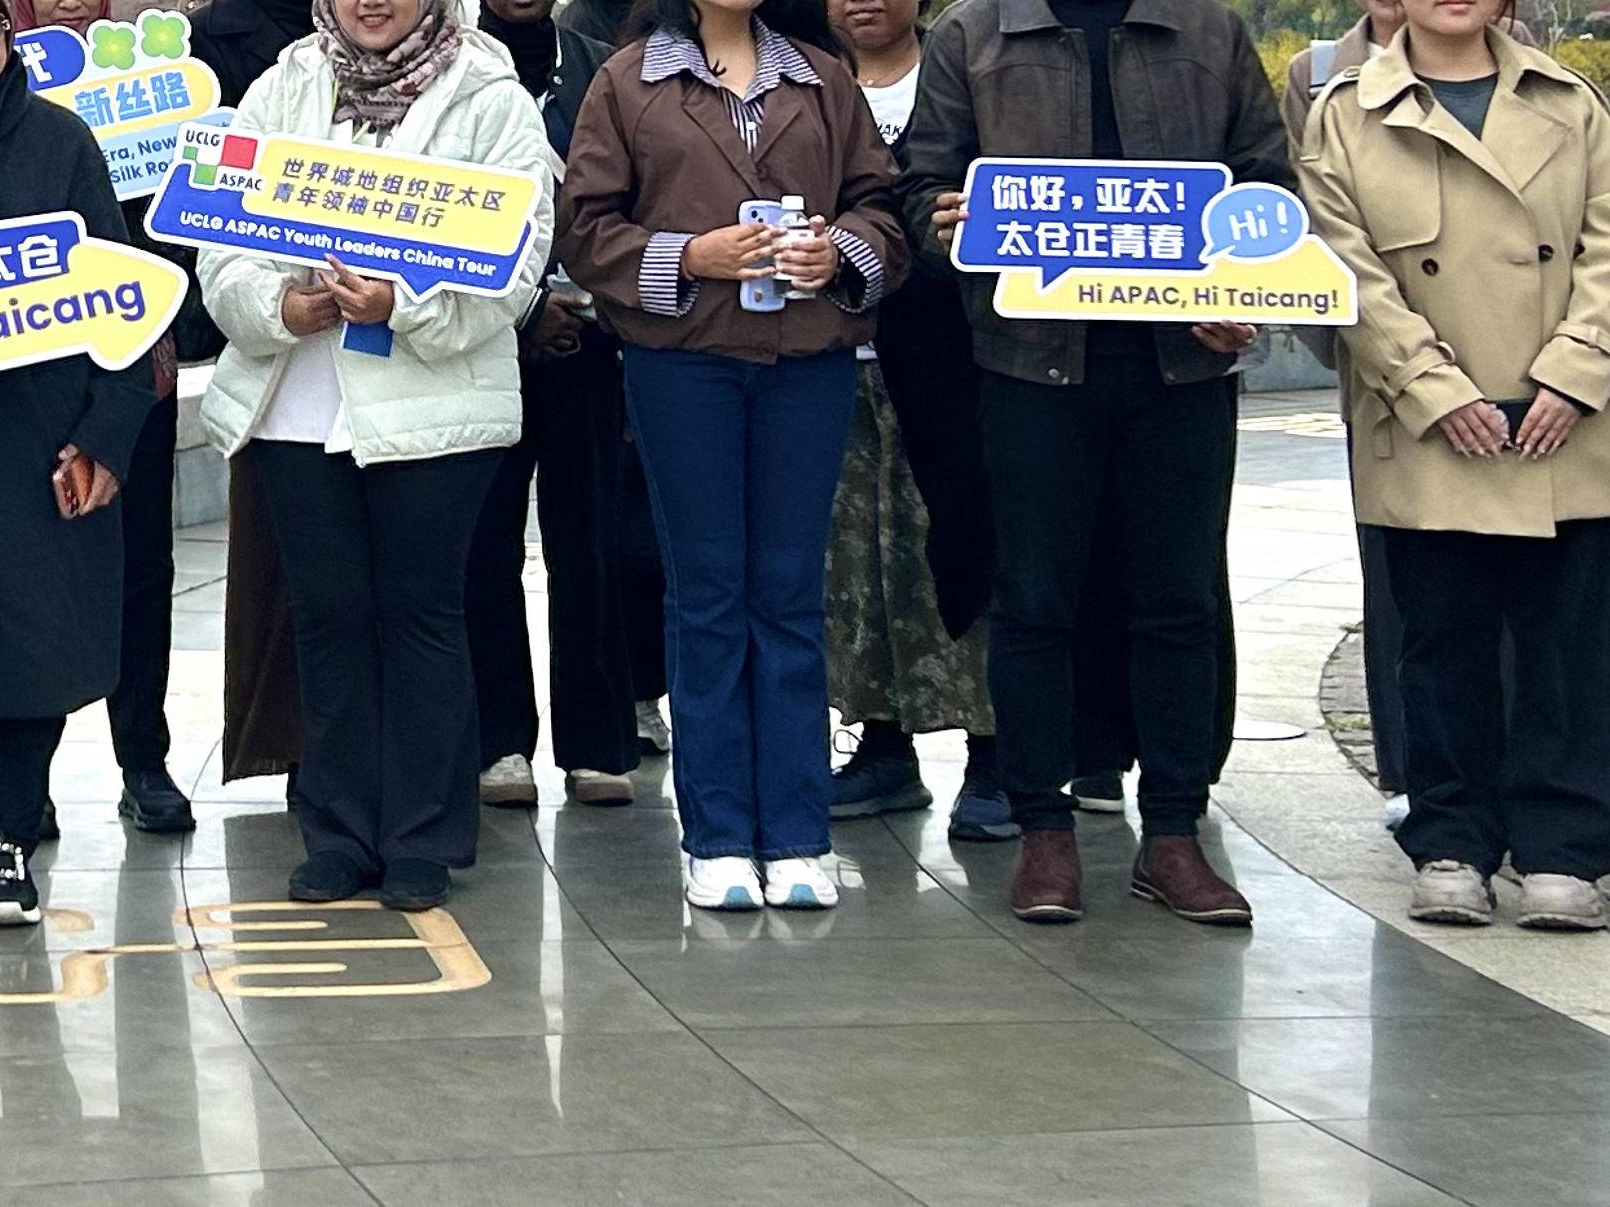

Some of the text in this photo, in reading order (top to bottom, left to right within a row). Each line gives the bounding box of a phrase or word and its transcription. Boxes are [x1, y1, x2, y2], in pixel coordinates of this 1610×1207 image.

[74, 72, 192, 127] 新丝路
[137, 136, 177, 156] New
[185, 130, 221, 147] UCLG
[110, 161, 169, 183] Silk Ro
[219, 173, 263, 191] ASPAC
[281, 158, 506, 212] 世界城地组织亚太区
[272, 182, 446, 228] 青年领袖中国行
[179, 210, 497, 277] UCLG ASPAC Youth Leaders China Tour
[996, 222, 1185, 260] 太仓正青春
[1078, 283, 1339, 315] Hi APAC, Hi Taicang!
